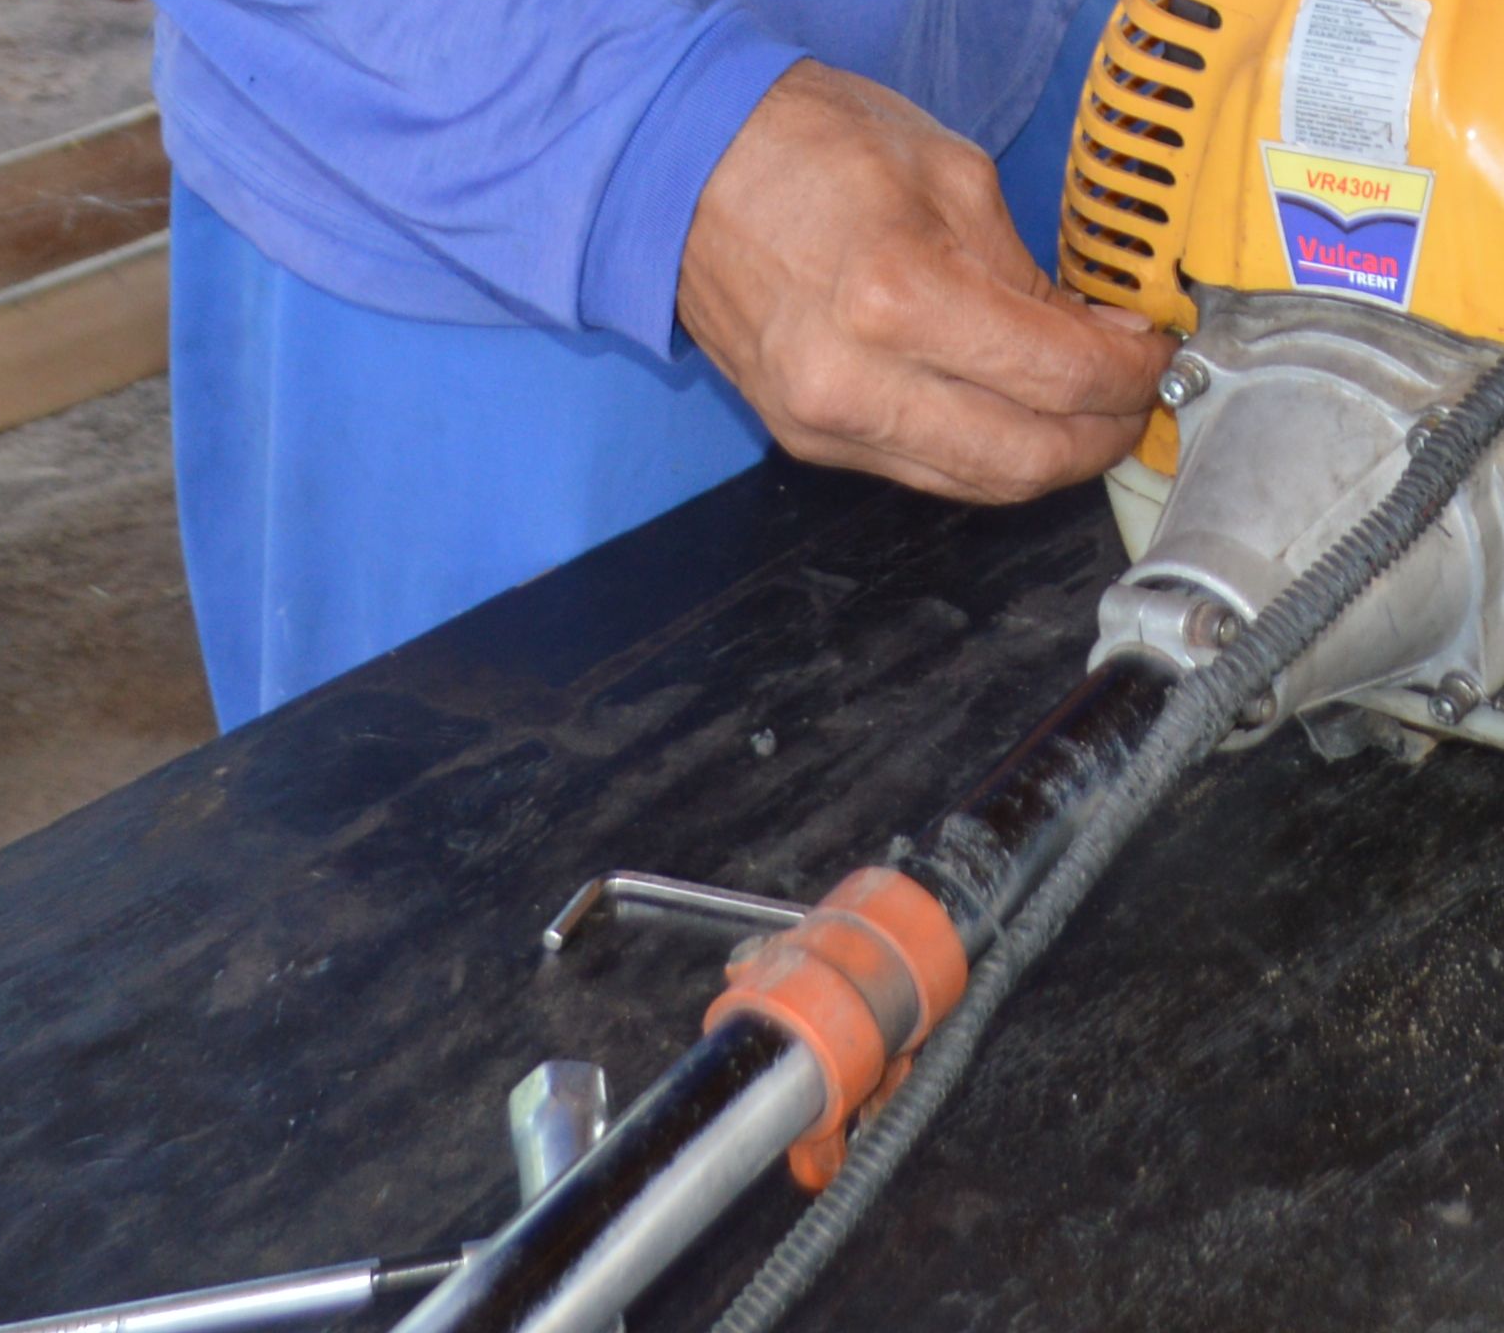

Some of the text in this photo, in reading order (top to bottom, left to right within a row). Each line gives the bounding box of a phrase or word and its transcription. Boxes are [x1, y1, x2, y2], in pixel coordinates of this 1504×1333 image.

[1306, 169, 1391, 203] VR430H
[1297, 235, 1399, 278] Vulcan
[1348, 271, 1398, 292] TRENT
